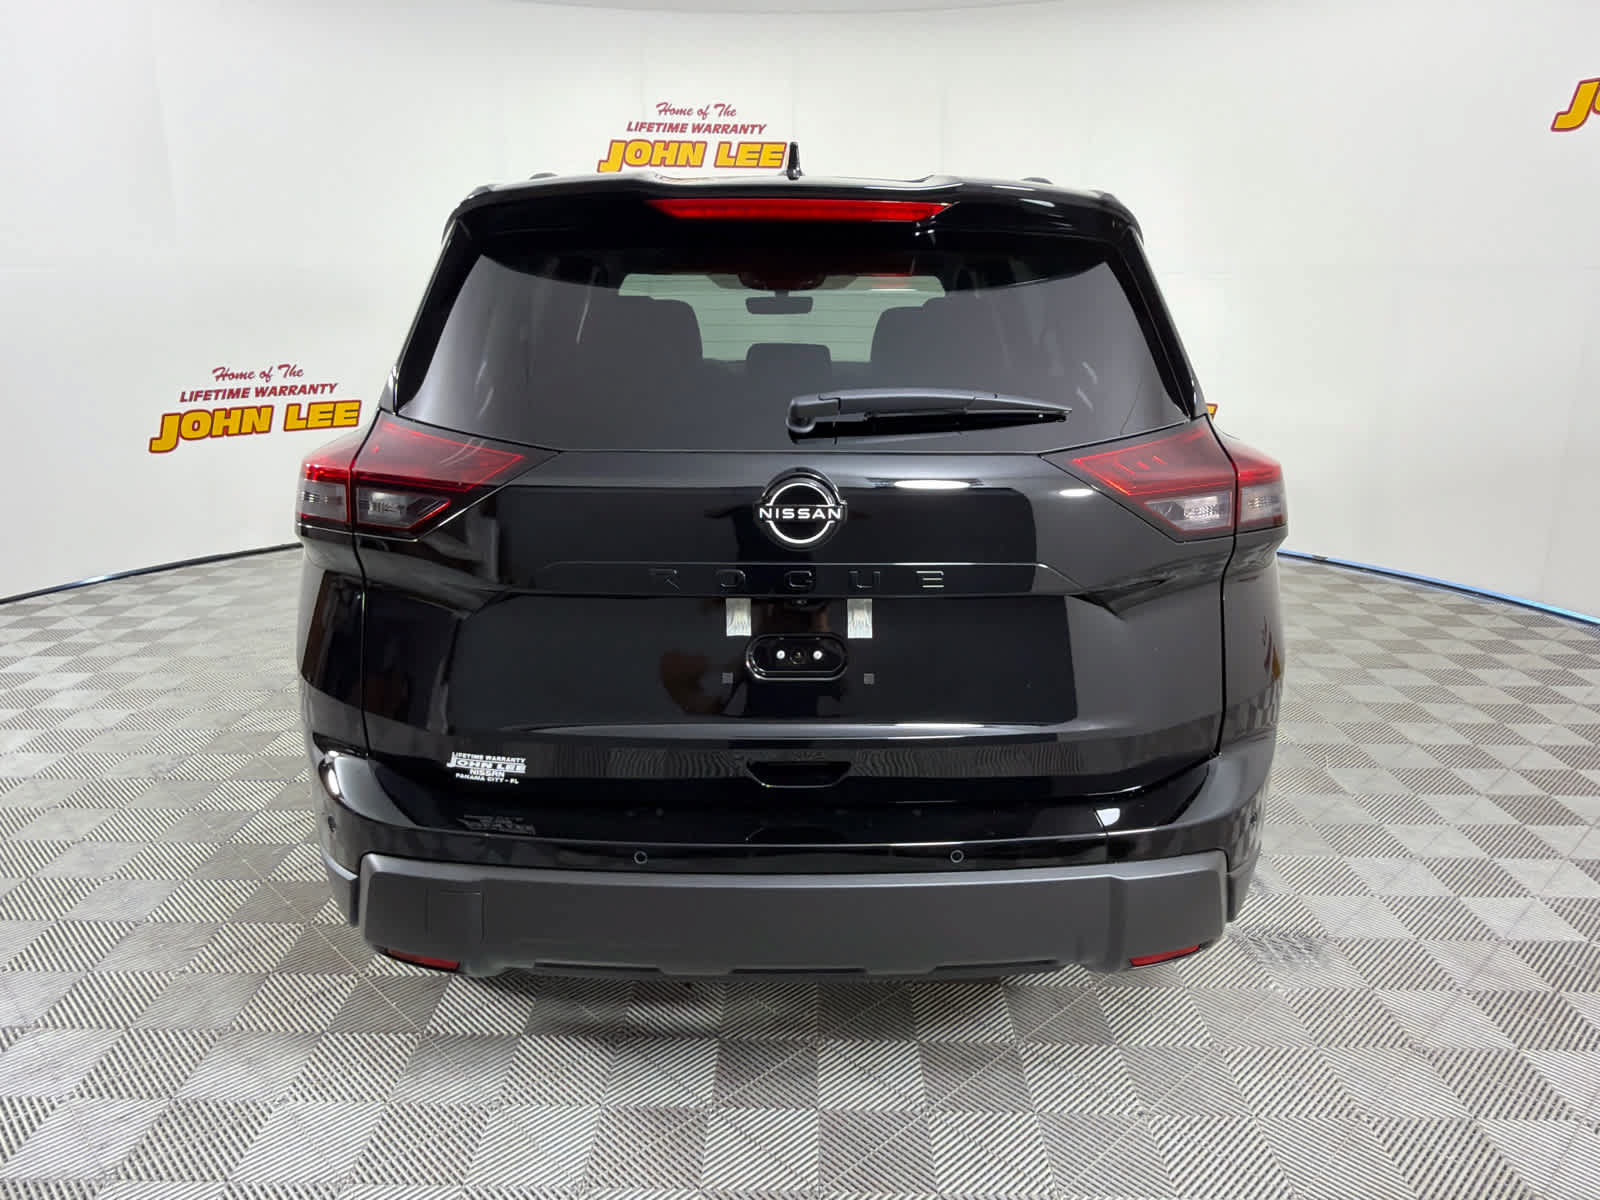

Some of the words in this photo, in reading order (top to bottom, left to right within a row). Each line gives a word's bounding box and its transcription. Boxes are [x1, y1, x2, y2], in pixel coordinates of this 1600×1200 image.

[656, 102, 693, 117] Home
[697, 103, 709, 120] of
[713, 103, 737, 117] The
[626, 121, 688, 134] LIFETIME
[691, 123, 767, 135] WARRANTY
[597, 139, 708, 173] JOHN
[714, 141, 787, 169] LEE
[212, 366, 255, 382] Home
[259, 366, 274, 384] of
[278, 363, 304, 378] The
[179, 387, 251, 403] LIFETIME
[254, 382, 339, 399] WARRANTY
[149, 405, 274, 453] JOHN
[283, 399, 362, 432] LEE
[759, 507, 842, 520] NISSAN
[649, 568, 945, 592] ROGUE
[485, 755, 526, 763] WARRANTY
[455, 773, 485, 781] PANAMA
[469, 768, 505, 777] NISSAN
